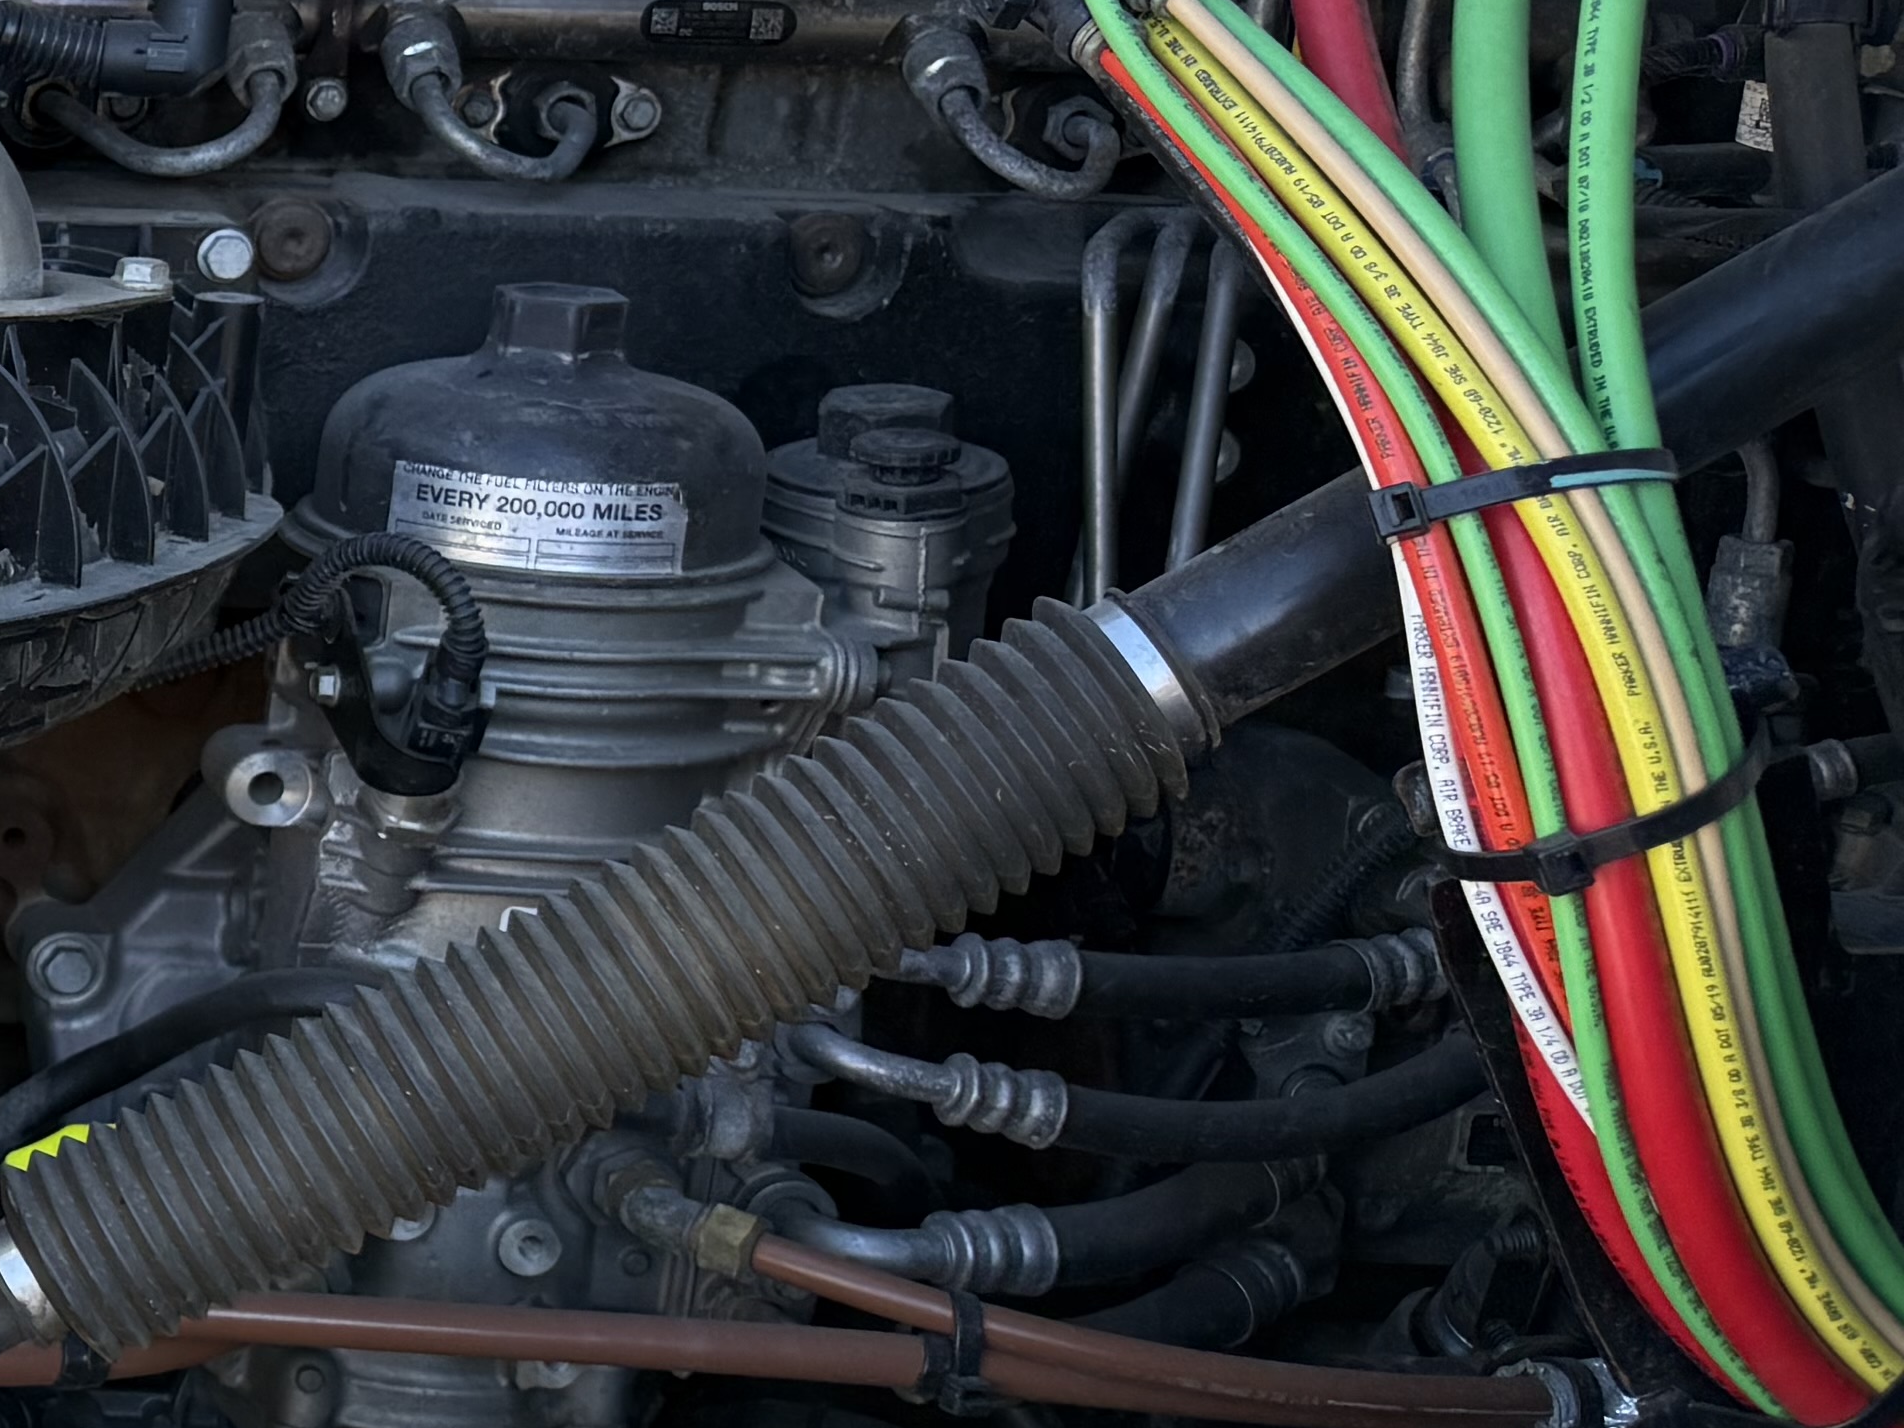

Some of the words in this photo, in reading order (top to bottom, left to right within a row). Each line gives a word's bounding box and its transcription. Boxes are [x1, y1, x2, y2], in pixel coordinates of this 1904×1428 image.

[416, 483, 490, 510] EVERY
[496, 496, 584, 520] 200,000
[592, 503, 662, 522] MILES
[458, 470, 482, 484] THE
[608, 483, 633, 496] THE
[422, 511, 446, 522] DATE
[450, 514, 502, 531] SERVICED
[555, 526, 602, 539] MILEAGE
[605, 530, 619, 539] AT
[622, 530, 664, 540] SERVICE
[1546, 509, 1571, 537] AIR
[1566, 543, 1592, 581] CORP.
[1410, 613, 1434, 660] PARKER
[1580, 587, 1623, 654] HANNIFIN
[1419, 661, 1445, 717] HANNIFIN
[1614, 653, 1642, 698] PARKER
[1426, 721, 1450, 772] CORP.
[1438, 779, 1459, 807] AIR
[1444, 809, 1473, 850] BRAKE
